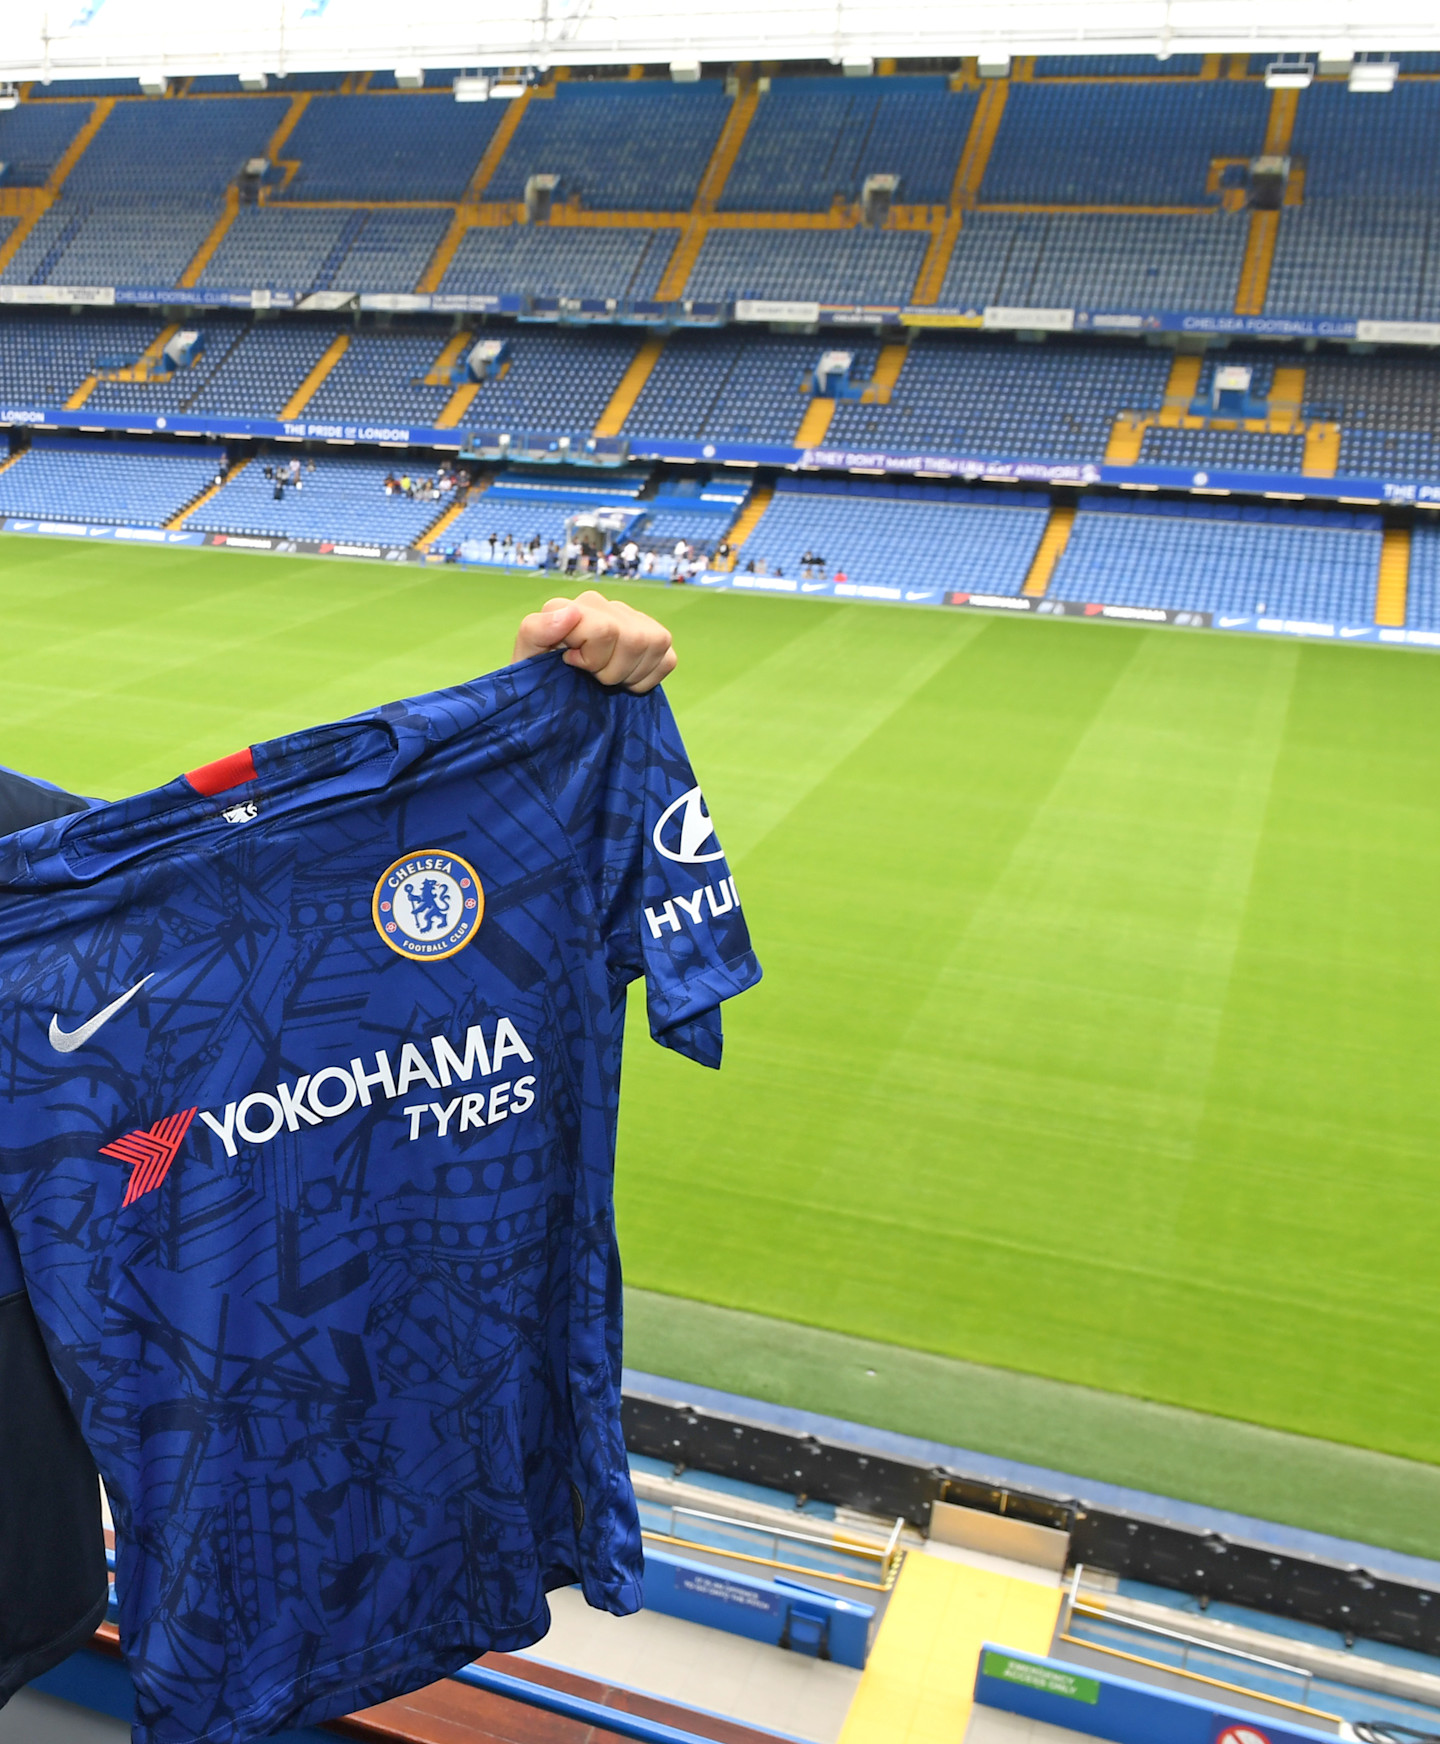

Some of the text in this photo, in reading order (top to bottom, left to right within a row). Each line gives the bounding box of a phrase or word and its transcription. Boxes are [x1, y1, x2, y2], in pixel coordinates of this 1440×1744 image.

[1182, 316, 1354, 336] CHELSEA FOOTBALL CLUB
[1, 410, 45, 423] LONDON
[283, 423, 306, 436] THE
[308, 424, 343, 438] PRIDE
[358, 427, 409, 441] LONDON
[1382, 483, 1417, 499] THE
[388, 858, 453, 888] CHELSEA
[402, 921, 469, 953] FOOTBALL CLUB
[199, 1017, 535, 1157] YOKOHAMA
[403, 1075, 536, 1141] TYRES
